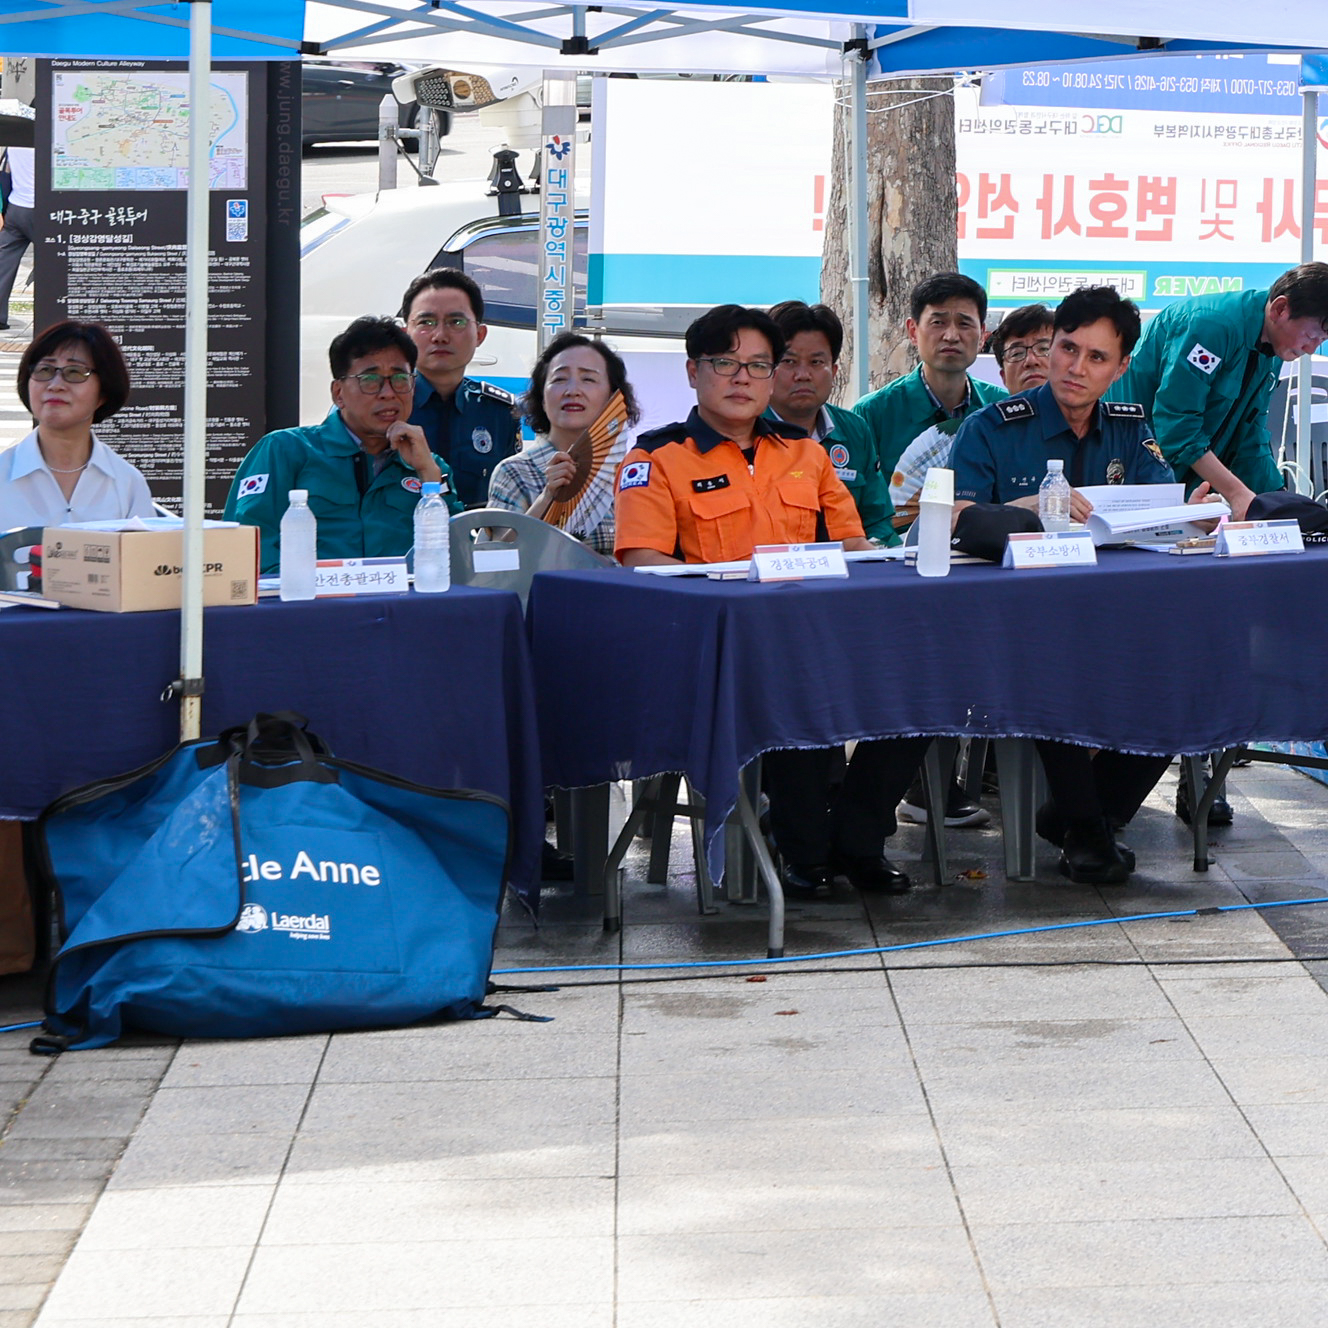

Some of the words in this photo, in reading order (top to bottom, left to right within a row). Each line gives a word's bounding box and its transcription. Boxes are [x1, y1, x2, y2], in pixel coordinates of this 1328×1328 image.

[276, 60, 294, 226] ww.jung.daegu.kr
[1236, 532, 1290, 547] 중부경찰서
[1025, 544, 1082, 559] 중부소방서
[769, 556, 830, 572] 경찰특공대
[289, 850, 381, 887] Anne
[271, 911, 331, 931] Laerdal
